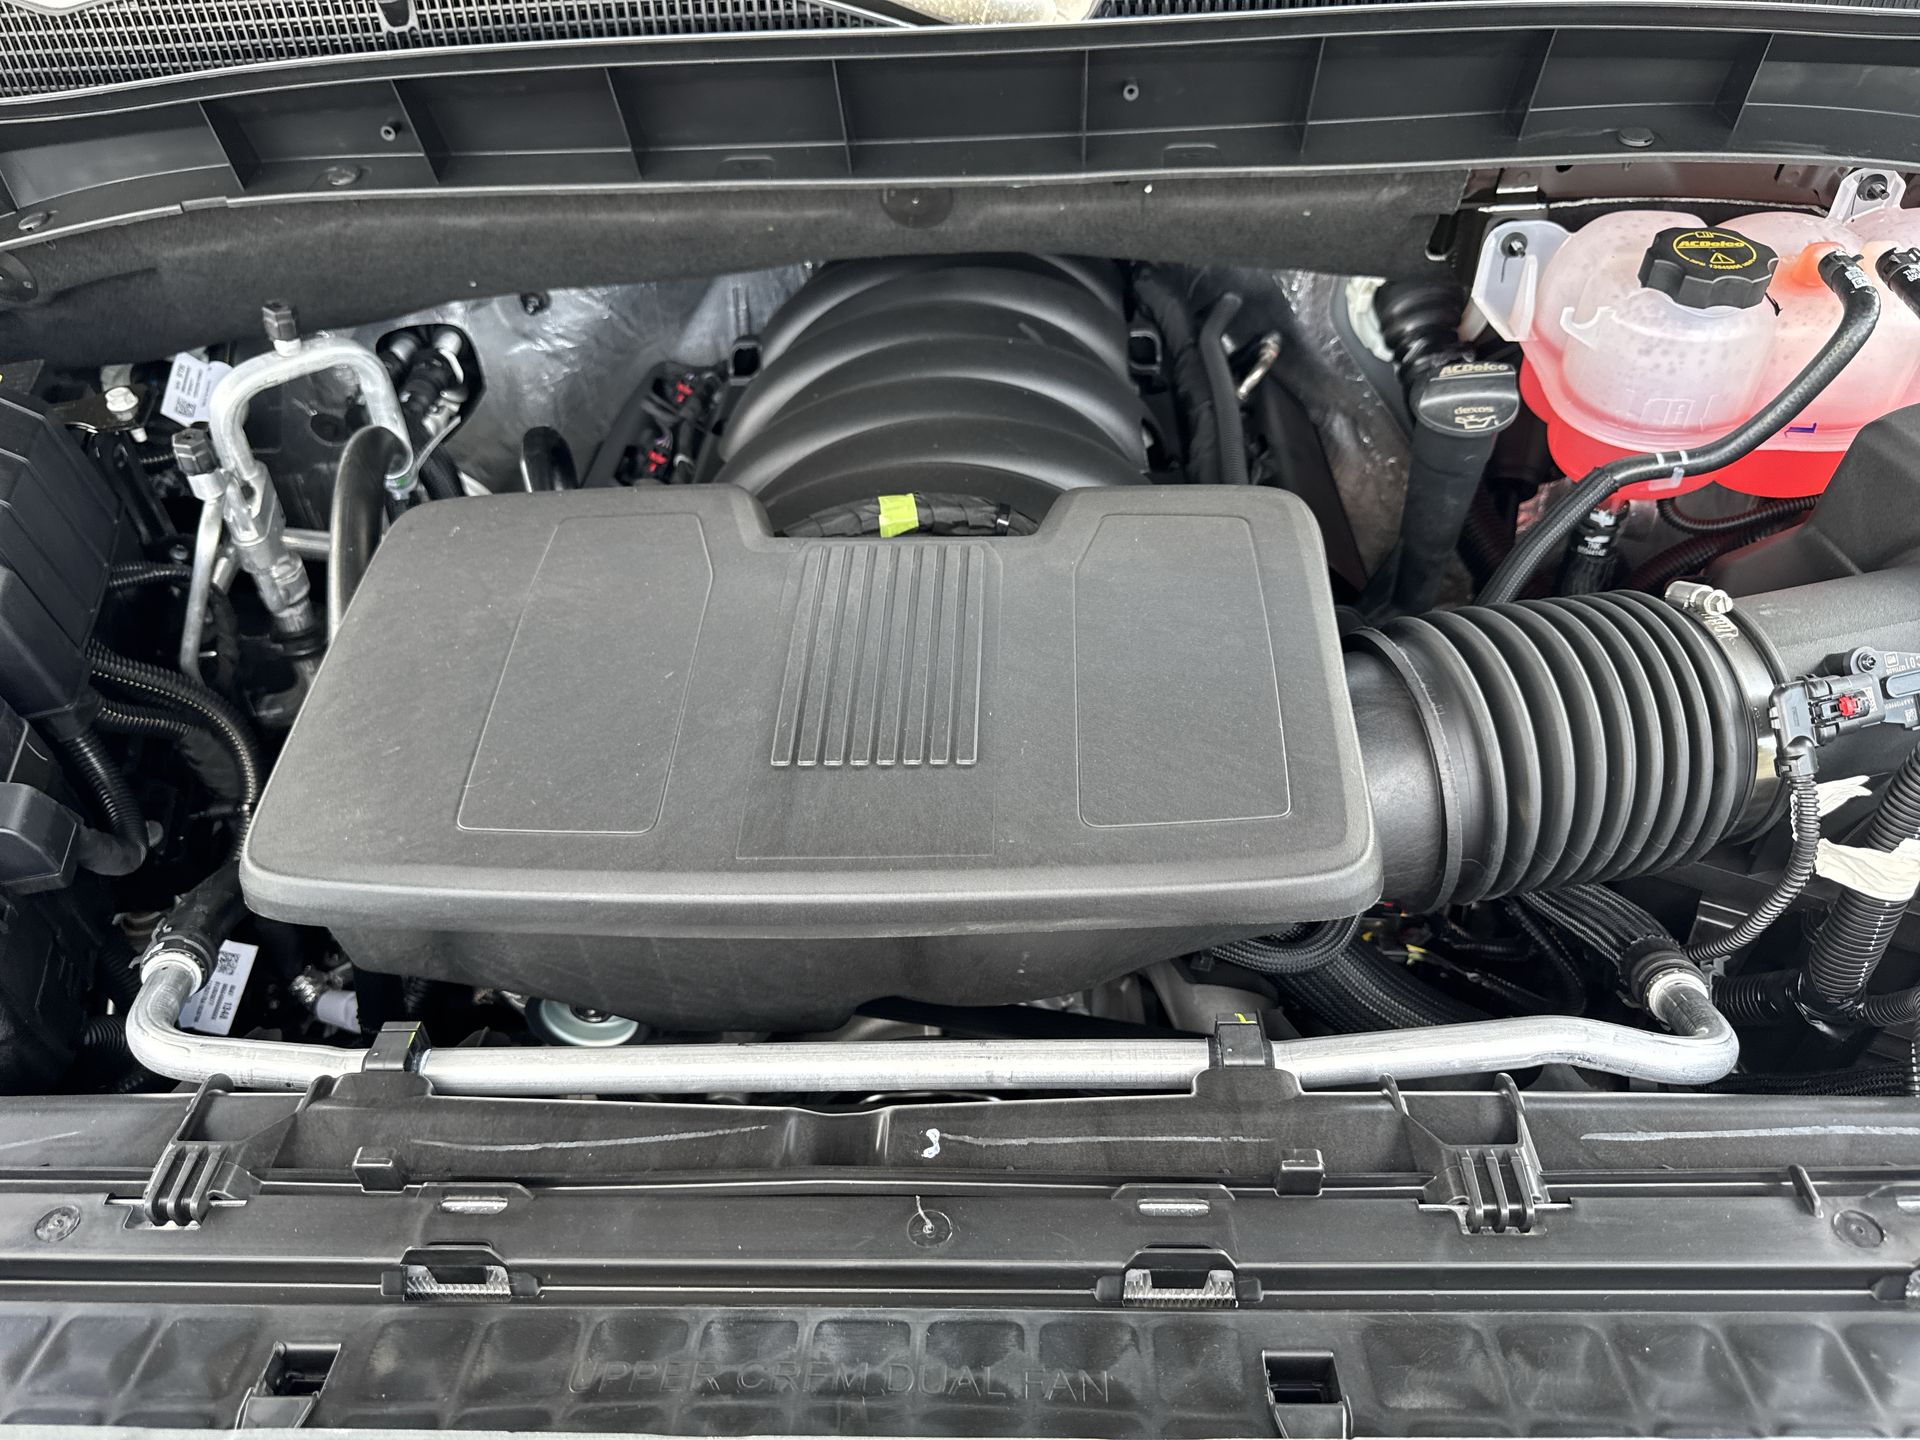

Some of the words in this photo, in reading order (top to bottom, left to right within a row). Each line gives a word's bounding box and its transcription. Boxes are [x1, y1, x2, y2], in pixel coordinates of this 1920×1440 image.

[1677, 240, 1745, 249] ACDelco
[1439, 362, 1509, 378] ACDelco
[1454, 406, 1494, 415] dexos
[568, 1360, 720, 1393] UPPER
[736, 1361, 870, 1391] CRFM
[883, 1363, 1006, 1397] DUAL
[1024, 1368, 1110, 1403] FAN
